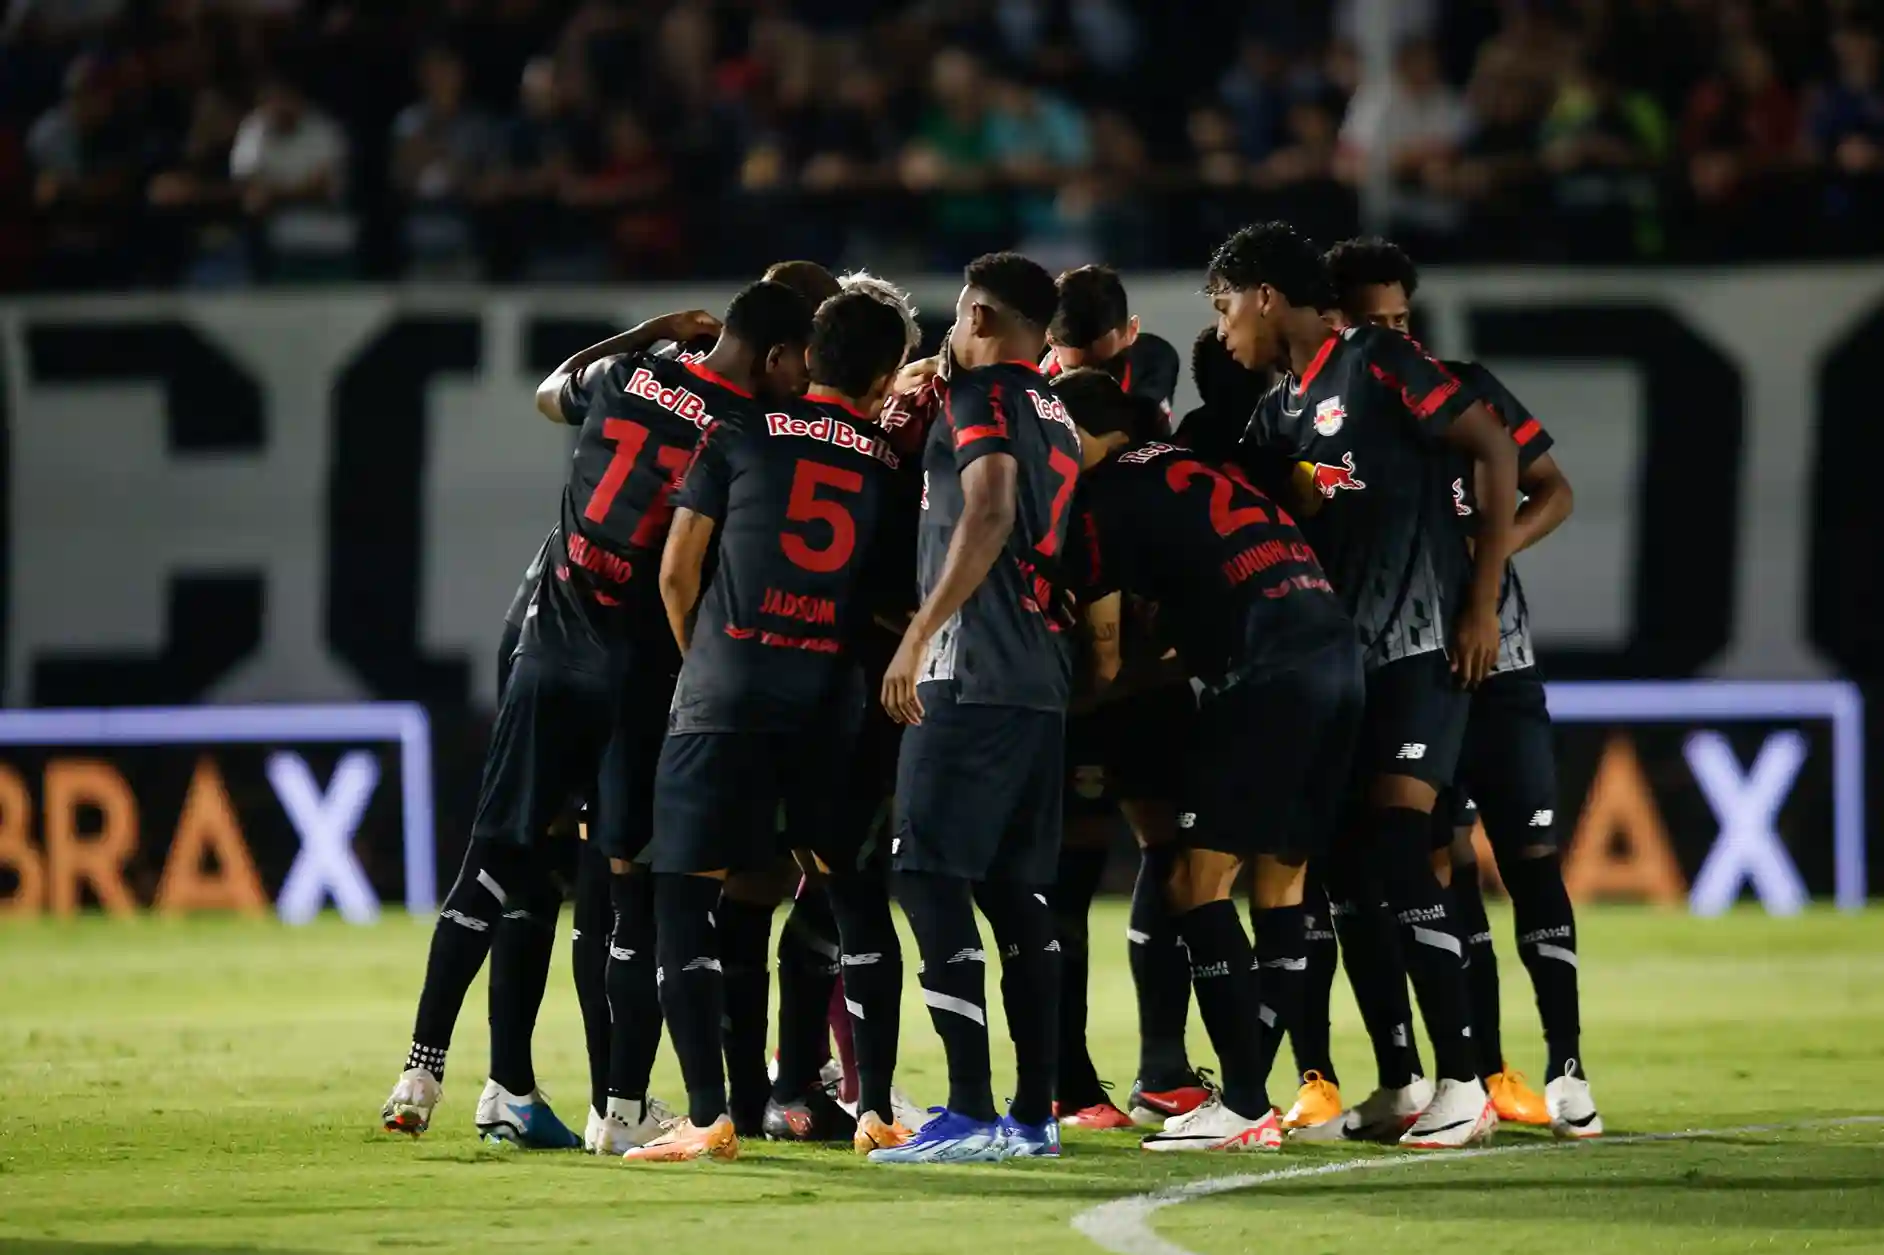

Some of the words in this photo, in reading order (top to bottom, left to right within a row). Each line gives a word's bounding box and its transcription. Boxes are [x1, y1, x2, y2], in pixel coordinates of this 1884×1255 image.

[765, 412, 833, 442] Red
[778, 457, 864, 574] 5
[758, 587, 837, 626] JADSOM
